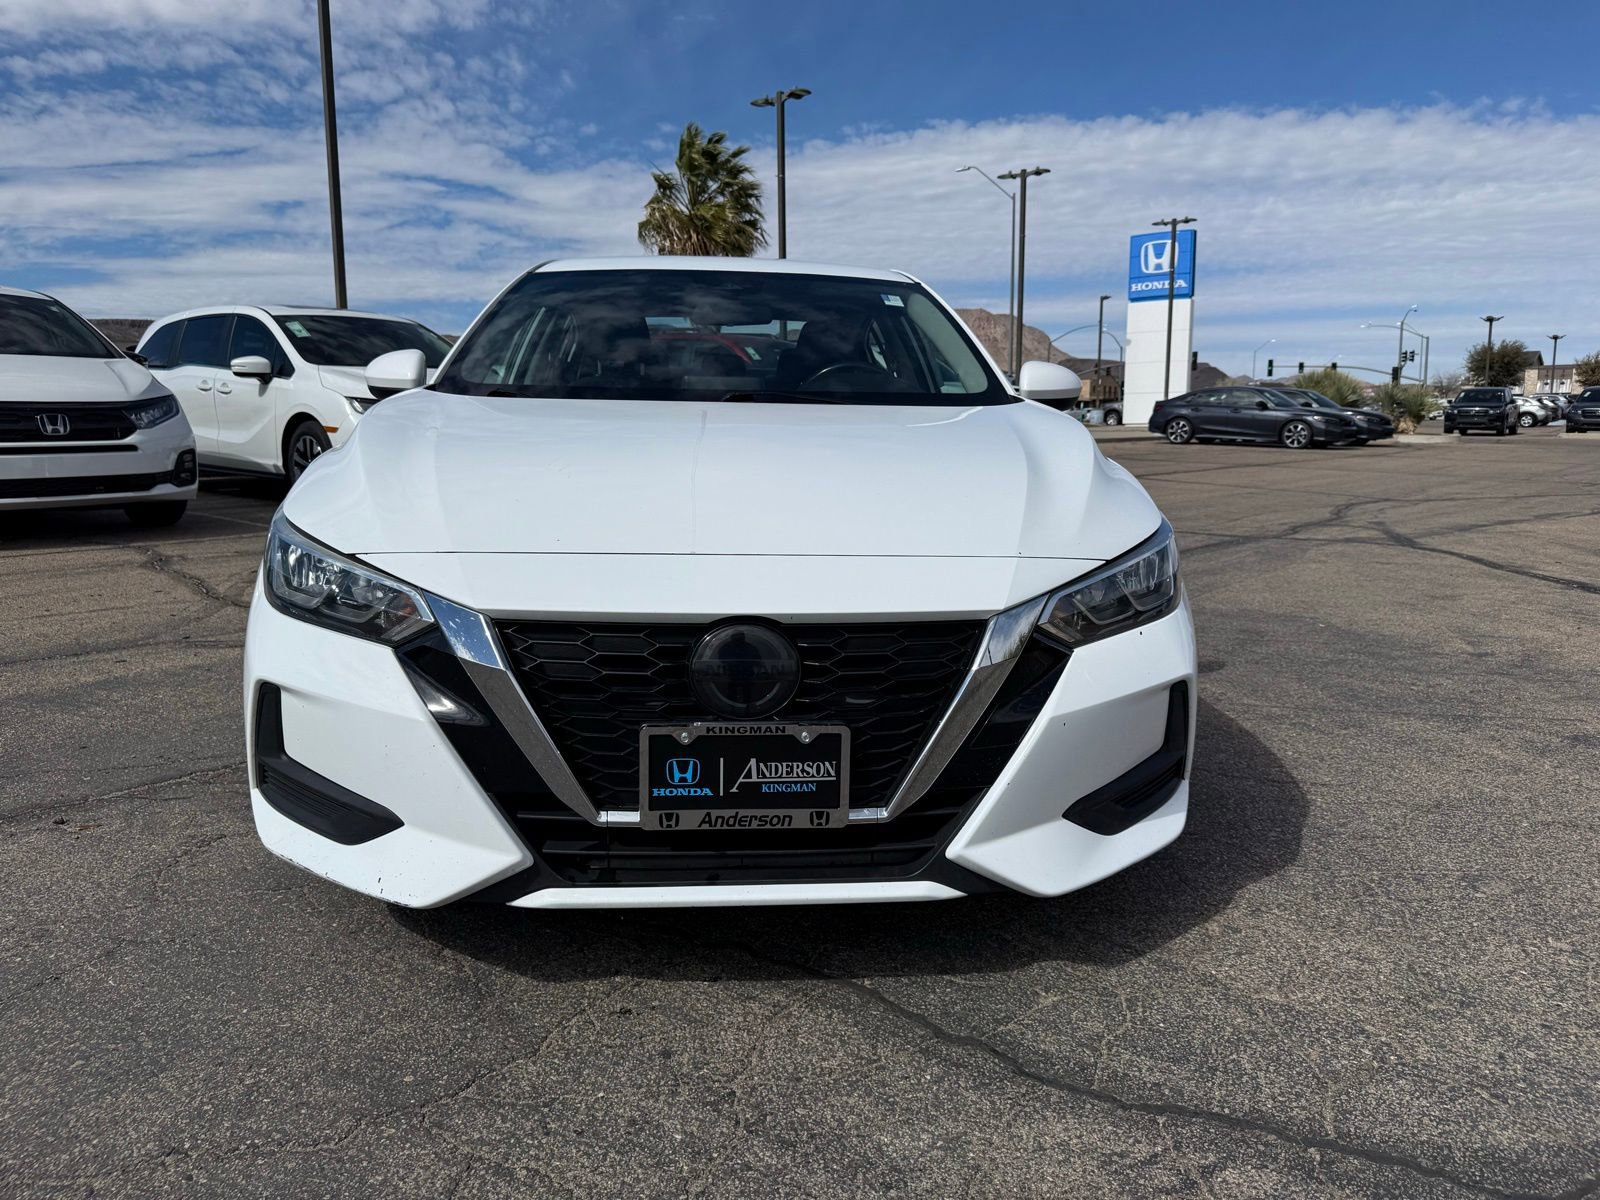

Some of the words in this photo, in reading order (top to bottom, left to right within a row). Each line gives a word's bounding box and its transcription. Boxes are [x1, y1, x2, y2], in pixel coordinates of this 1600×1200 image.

[706, 726, 786, 735] KINGMAN
[652, 788, 714, 796] HONDA
[762, 783, 816, 793] KINGMAN
[698, 811, 793, 828] Anderson
